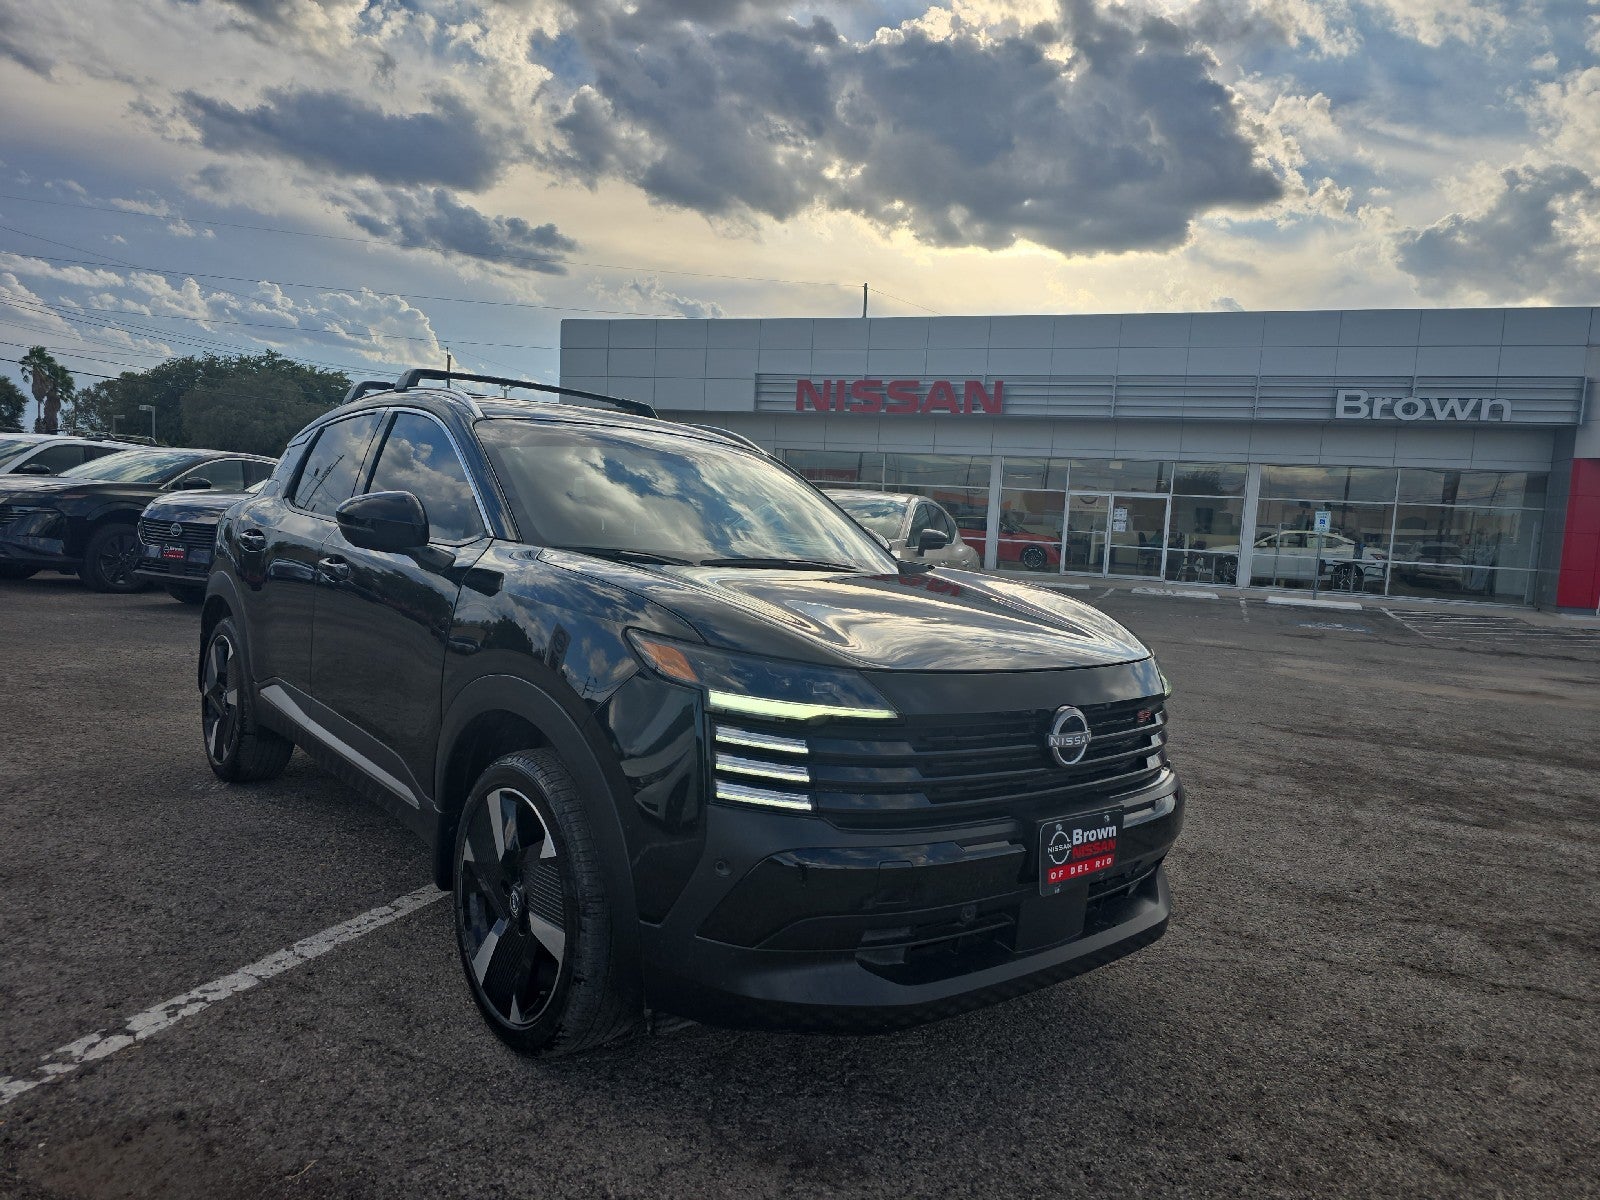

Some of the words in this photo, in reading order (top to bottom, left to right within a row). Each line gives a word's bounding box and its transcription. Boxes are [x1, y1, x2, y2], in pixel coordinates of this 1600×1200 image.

[795, 379, 1004, 415] NISSAN
[1334, 389, 1513, 422] Brown
[1049, 732, 1092, 746] NISSAN
[1072, 825, 1117, 846] Brown
[1047, 843, 1072, 854] NISSAN
[1072, 838, 1117, 859] NISSAN
[1050, 869, 1064, 880] OF
[1070, 863, 1089, 875] DEL
[1095, 857, 1112, 868] RIO
